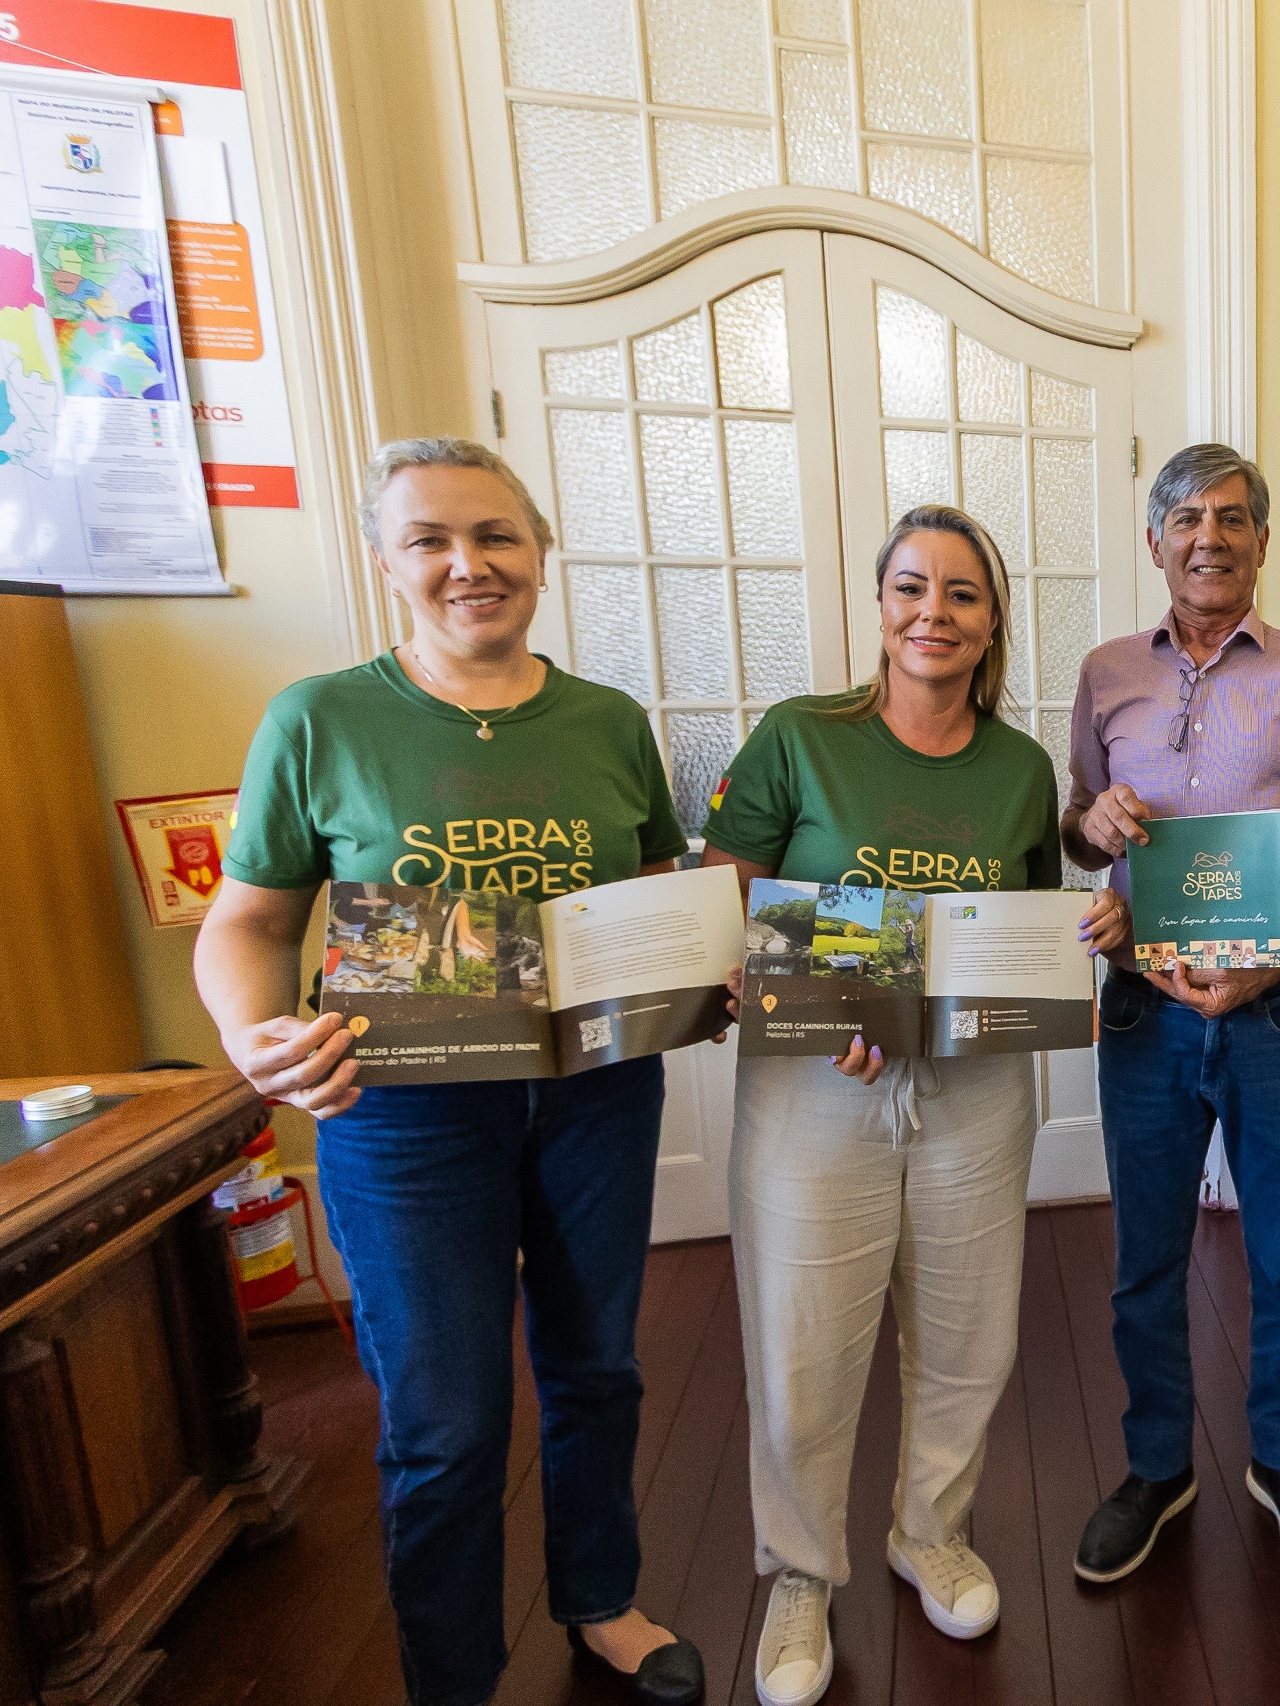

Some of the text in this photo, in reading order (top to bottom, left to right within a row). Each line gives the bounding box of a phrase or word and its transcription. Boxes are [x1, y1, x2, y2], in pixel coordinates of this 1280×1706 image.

[149, 811, 225, 829] EXTINTOR
[570, 818, 594, 857] DOS
[392, 818, 571, 888] SERRA
[839, 846, 985, 890] SERRA
[464, 862, 594, 896] TAPES
[1182, 870, 1235, 896] SERRA
[1234, 870, 1242, 886] DOS
[1202, 887, 1243, 901] TAPES
[1180, 915, 1207, 927] lugar
[1208, 914, 1221, 924] de
[1222, 912, 1270, 924] caminhos
[766, 998, 772, 1006] 3
[766, 1022, 793, 1030] DOCES
[835, 1023, 863, 1031] RURAIS
[355, 1042, 541, 1056] BELOS CAMINHOS DE ARROIO DO PADRE
[434, 1055, 447, 1064] RS
